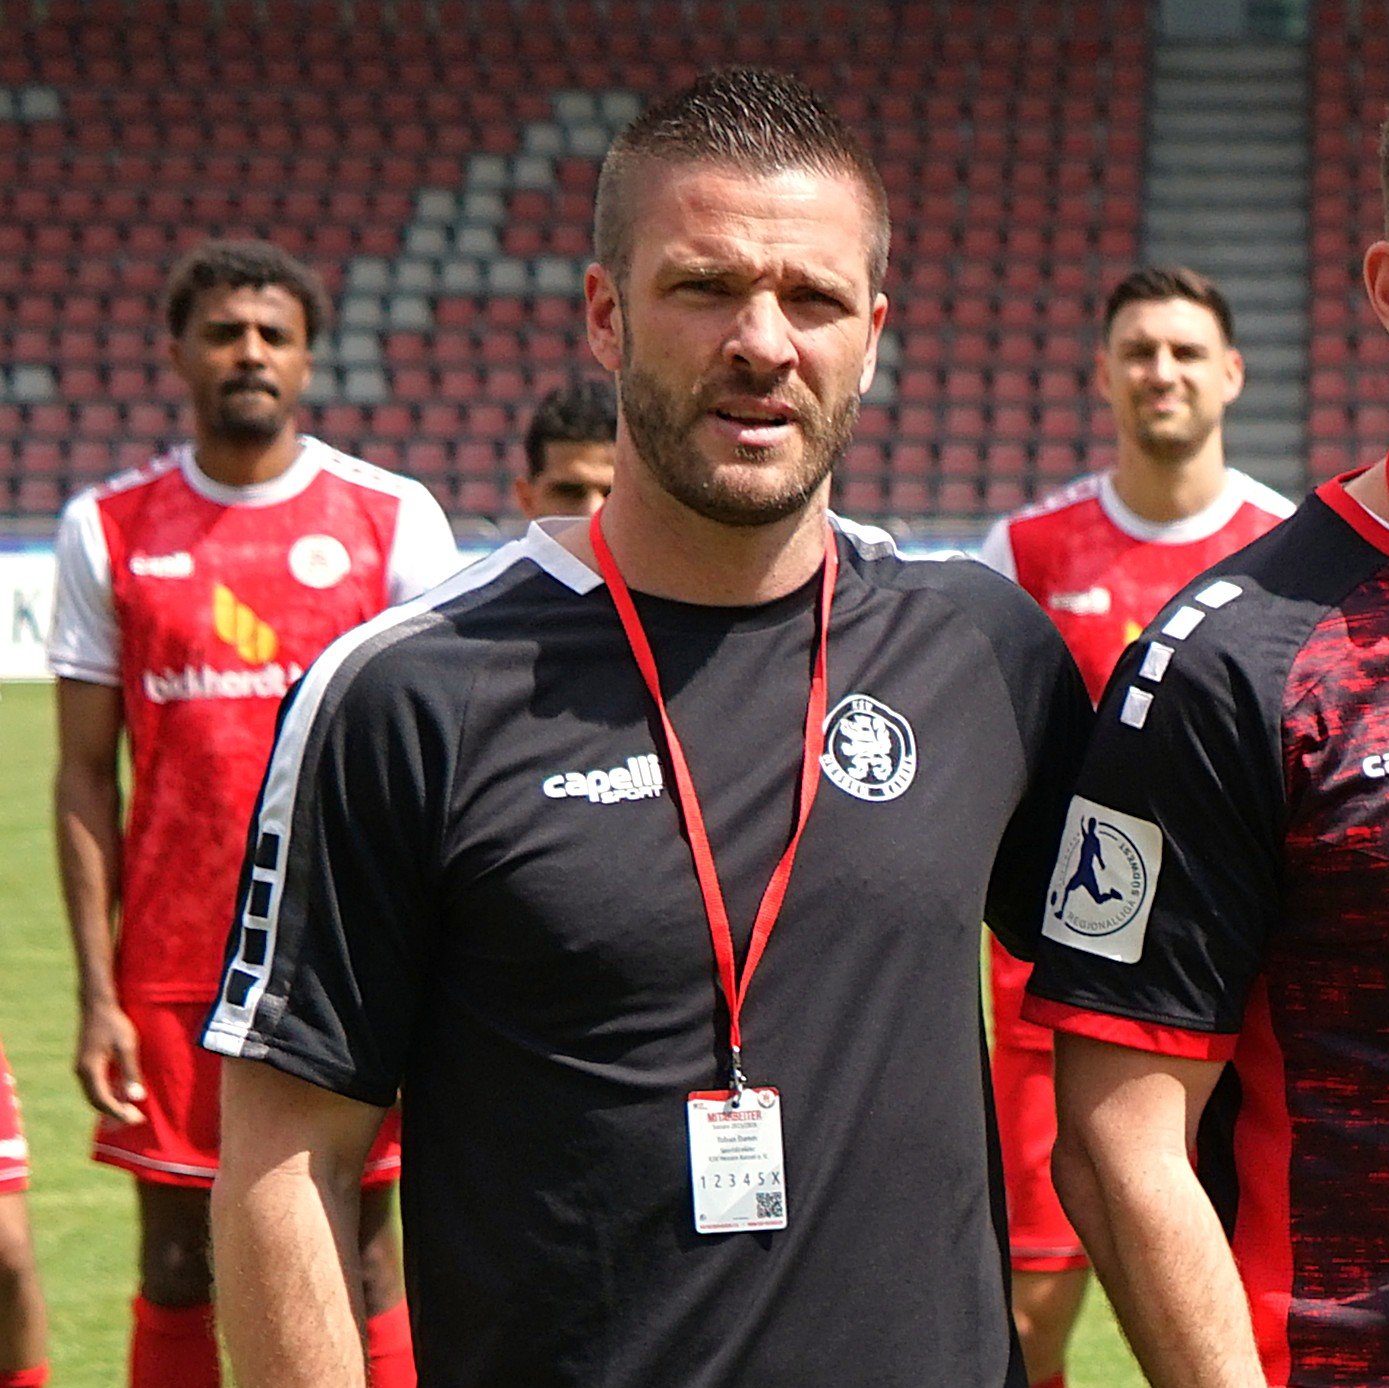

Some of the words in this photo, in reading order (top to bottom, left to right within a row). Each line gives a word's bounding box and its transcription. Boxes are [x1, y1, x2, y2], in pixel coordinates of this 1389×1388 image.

[543, 753, 664, 803] capelli
[600, 784, 664, 804] SPORT
[1066, 899, 1138, 932] REGIONALLIGA
[701, 1176, 706, 1189] 1
[714, 1175, 722, 1188] 2
[729, 1174, 736, 1187] 3
[743, 1173, 750, 1186] 4
[758, 1172, 765, 1185] 5
[771, 1171, 780, 1185] X
